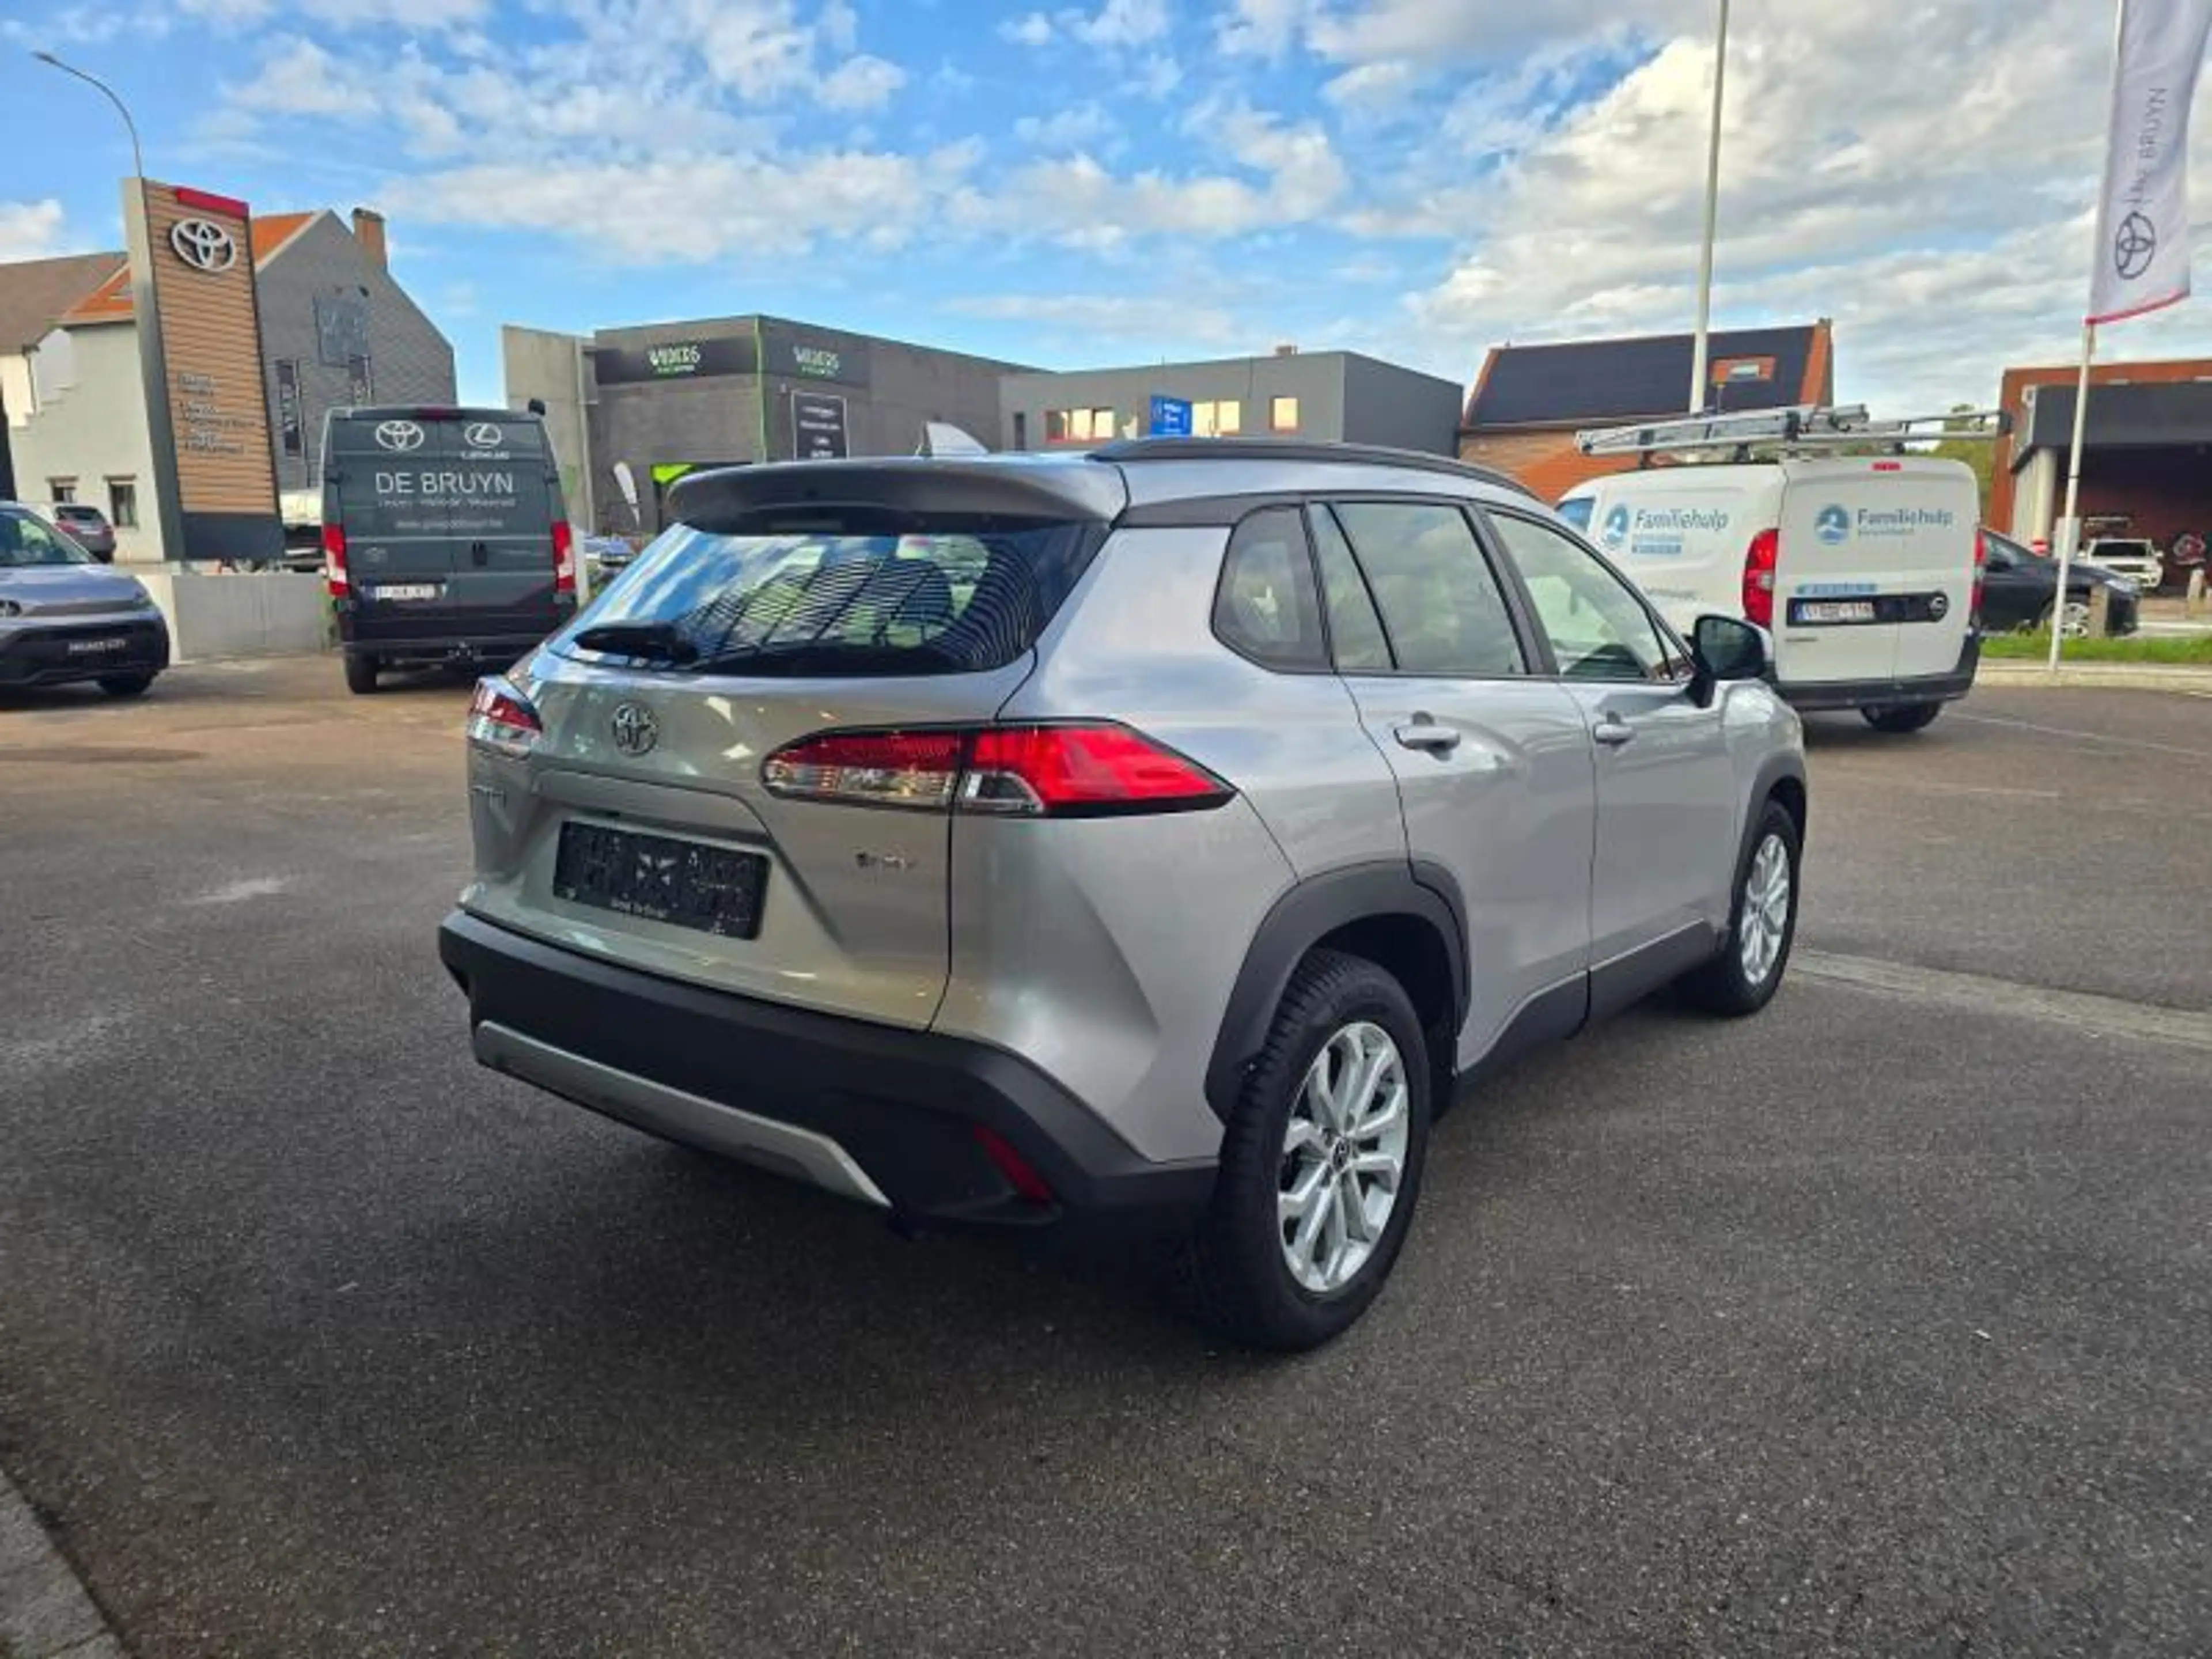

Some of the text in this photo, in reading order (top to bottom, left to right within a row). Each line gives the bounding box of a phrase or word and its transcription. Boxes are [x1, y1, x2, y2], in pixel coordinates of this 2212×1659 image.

[2139, 88, 2166, 158] BRUYN
[375, 472, 514, 494] DE BRUYN
